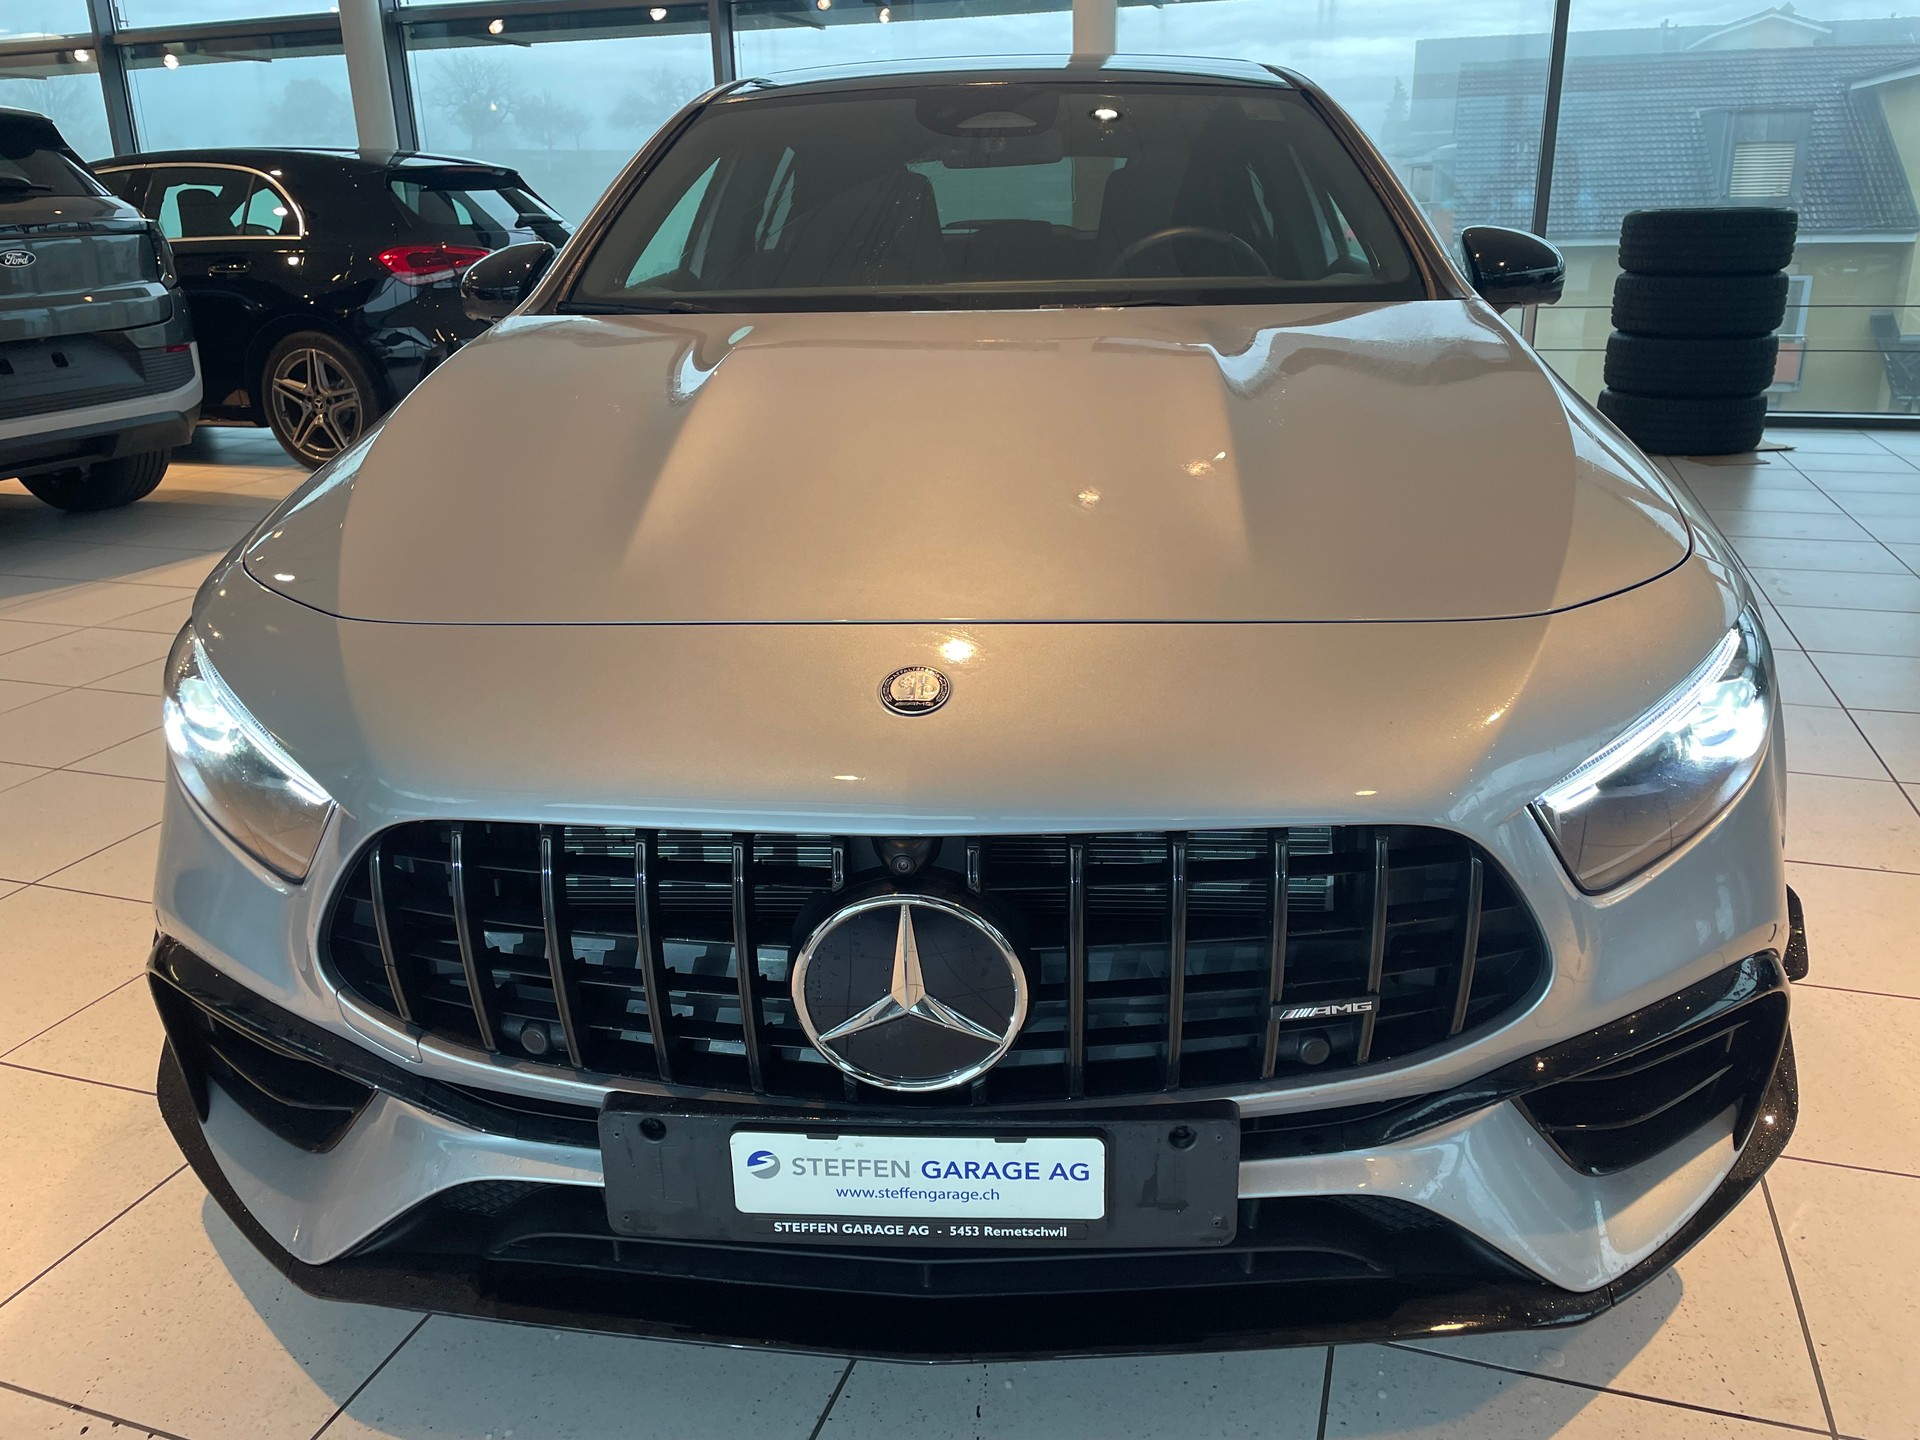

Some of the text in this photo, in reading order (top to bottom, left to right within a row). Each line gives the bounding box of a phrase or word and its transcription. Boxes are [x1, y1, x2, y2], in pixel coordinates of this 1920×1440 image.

[4, 252, 29, 265] Ford
[791, 1157, 1090, 1182] STEFFEN GARAGE AG
[836, 1187, 1000, 1203] www.steffengarage.ch
[773, 1221, 838, 1234] STEFFEN
[841, 1223, 904, 1236] GARAGE
[907, 1225, 930, 1236] AG
[949, 1226, 980, 1237] 5453
[983, 1226, 1068, 1238] Remetschwil
